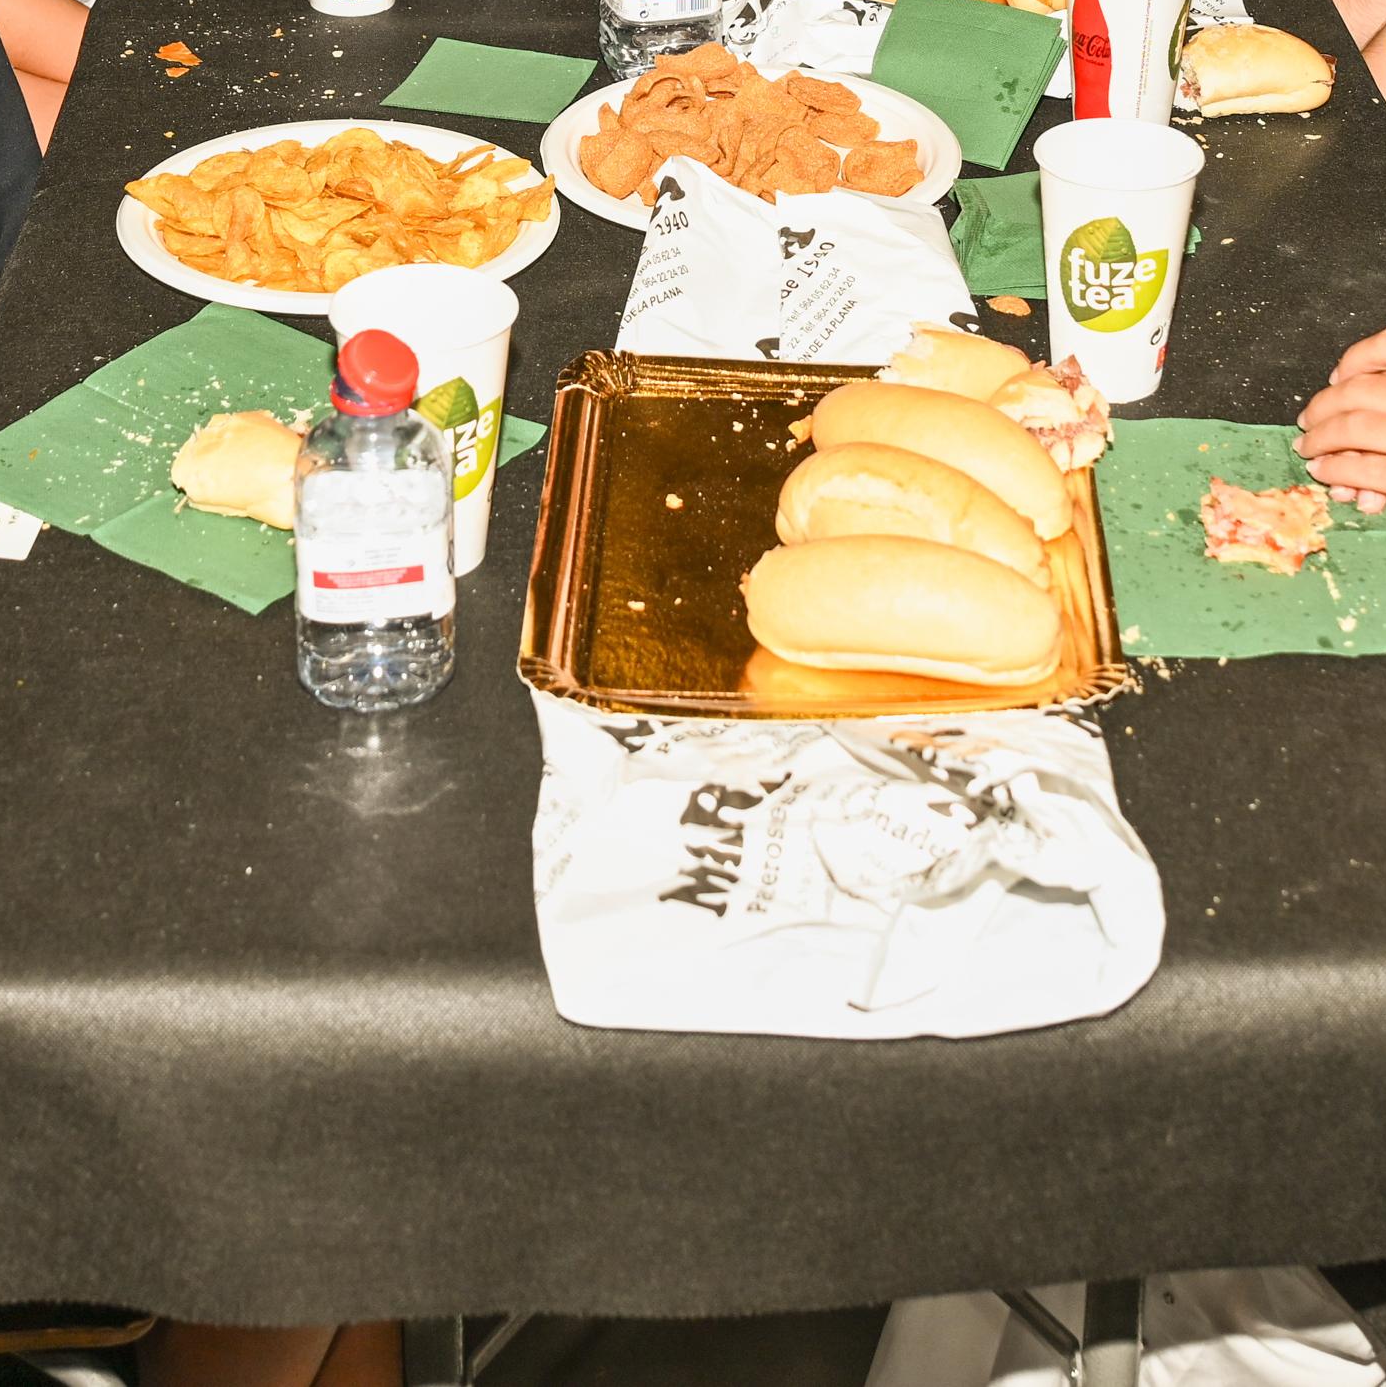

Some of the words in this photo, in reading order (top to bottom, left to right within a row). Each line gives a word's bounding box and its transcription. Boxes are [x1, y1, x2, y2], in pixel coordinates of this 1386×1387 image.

[1068, 247, 1156, 287] fuze
[650, 286, 684, 307] PLANA
[1069, 277, 1135, 311] tea
[809, 339, 824, 353] DE
[820, 327, 834, 340] LA
[830, 299, 858, 329] PLANA
